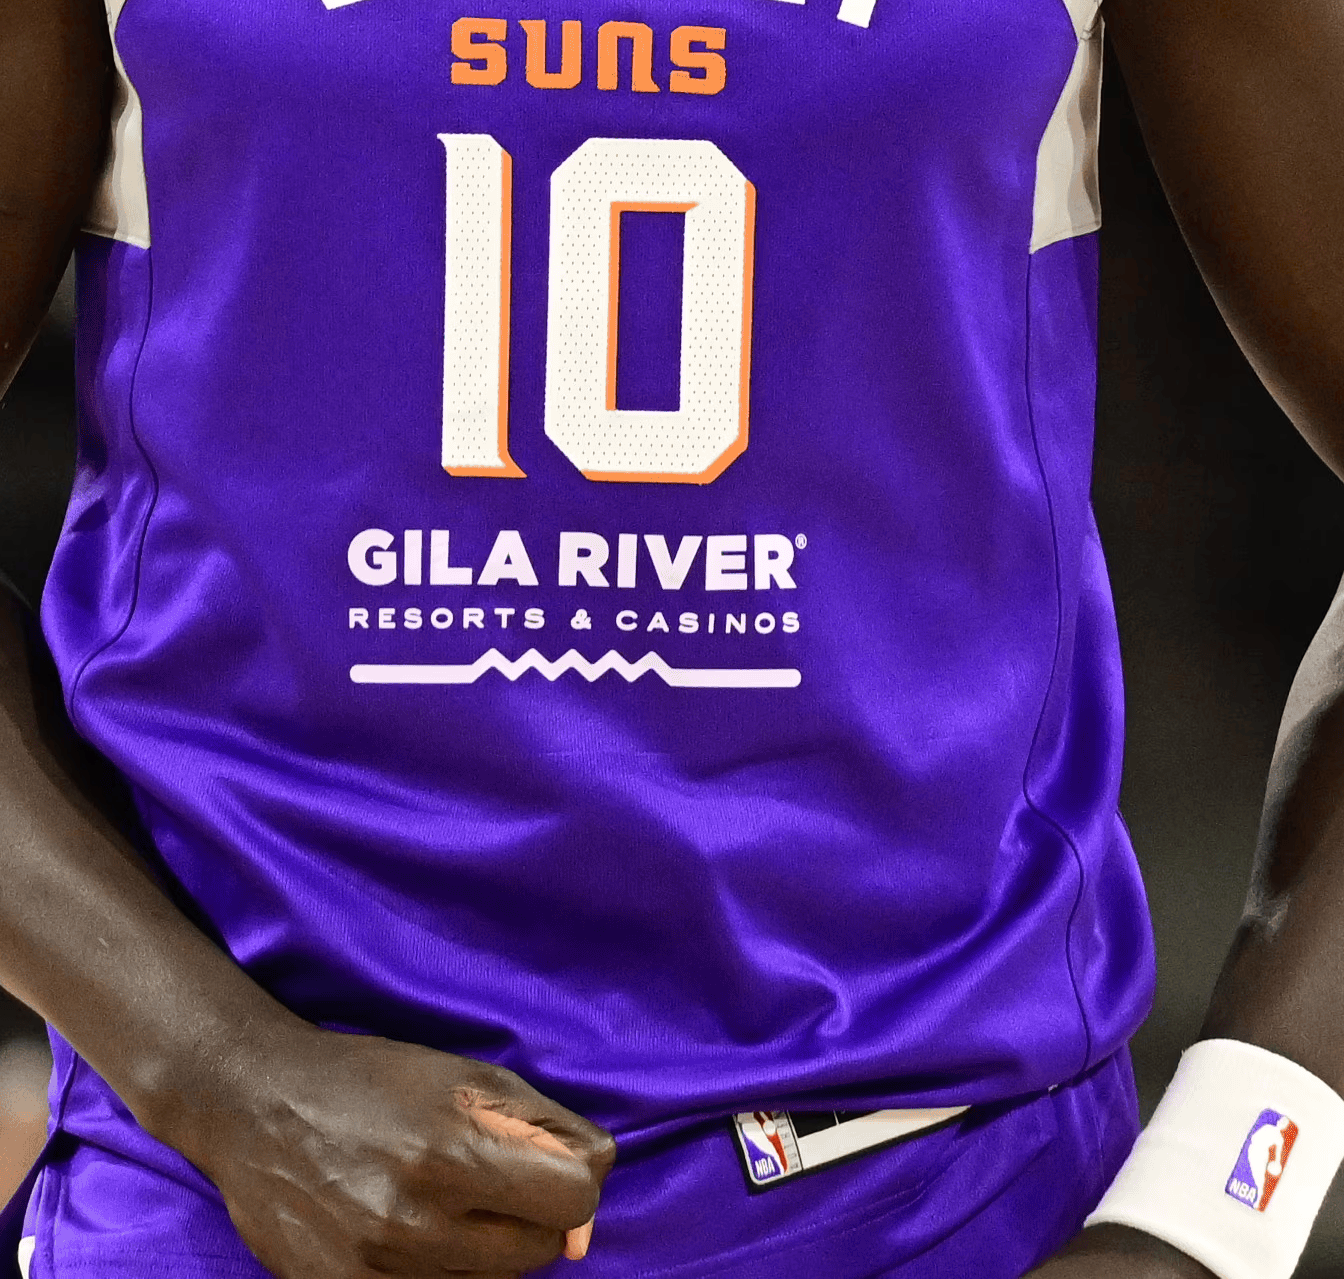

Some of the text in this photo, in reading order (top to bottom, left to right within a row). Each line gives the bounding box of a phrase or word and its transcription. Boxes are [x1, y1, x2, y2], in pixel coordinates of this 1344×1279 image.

[450, 17, 727, 95] SUNS
[437, 133, 756, 485] 10
[347, 528, 539, 586] GILA
[348, 607, 801, 634] RESORTS & CASINOS
[754, 1155, 776, 1179] NBA
[1228, 1177, 1258, 1204] NBA
